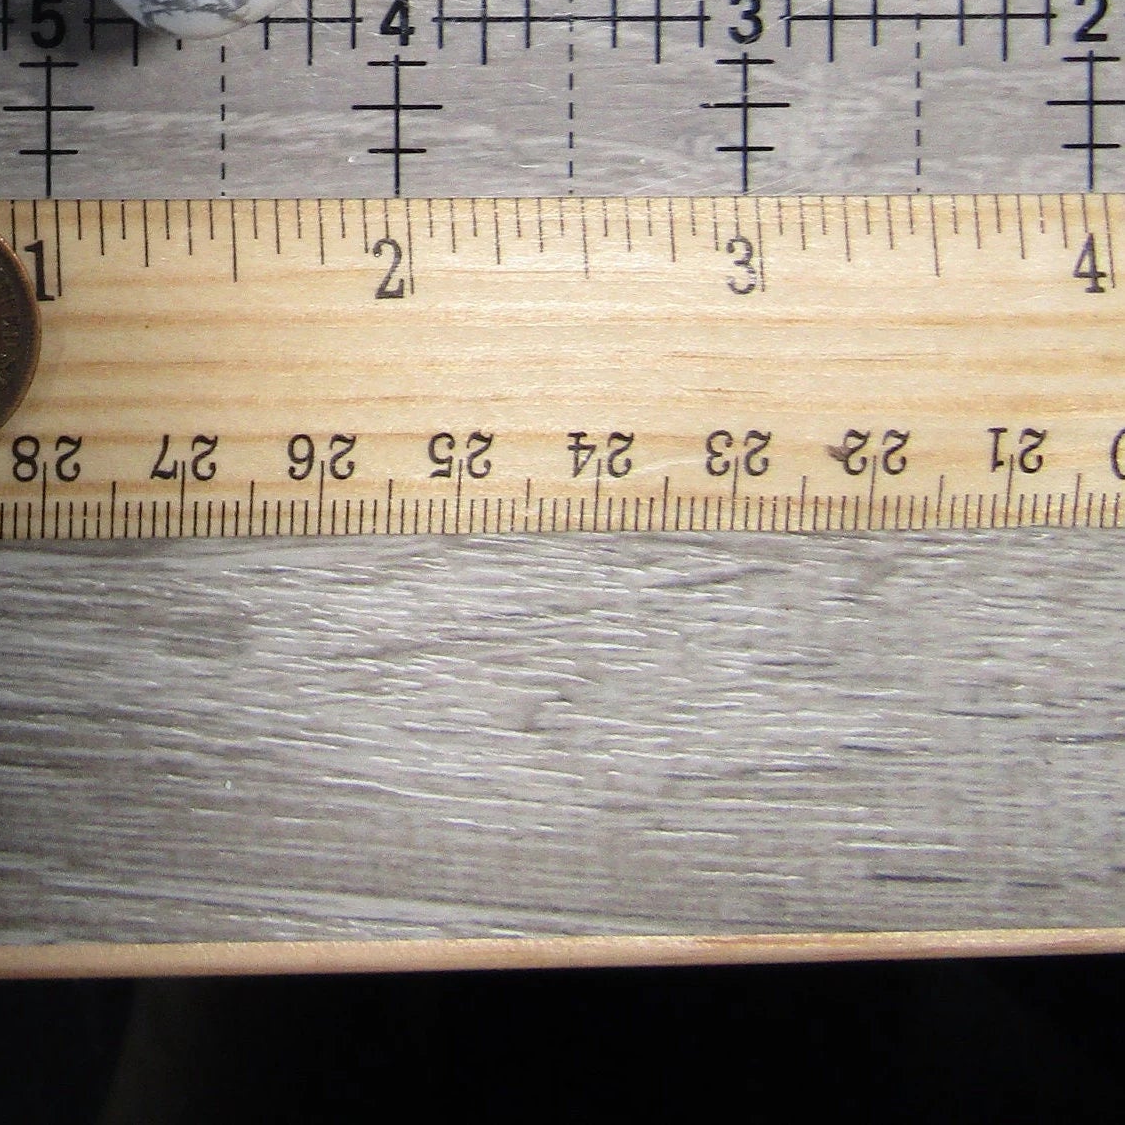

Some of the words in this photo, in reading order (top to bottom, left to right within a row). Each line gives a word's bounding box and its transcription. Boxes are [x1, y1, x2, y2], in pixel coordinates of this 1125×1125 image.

[24, 239, 56, 302] 1
[373, 237, 406, 299] 2
[726, 235, 759, 295] 3
[1074, 232, 1107, 294] 4
[12, 435, 83, 483] 28
[150, 434, 219, 480] 27
[286, 433, 357, 480] 26
[427, 431, 494, 479] 25
[567, 430, 635, 478] 24
[706, 429, 772, 477] 23
[842, 428, 911, 476] 22
[987, 427, 1048, 474] 21
